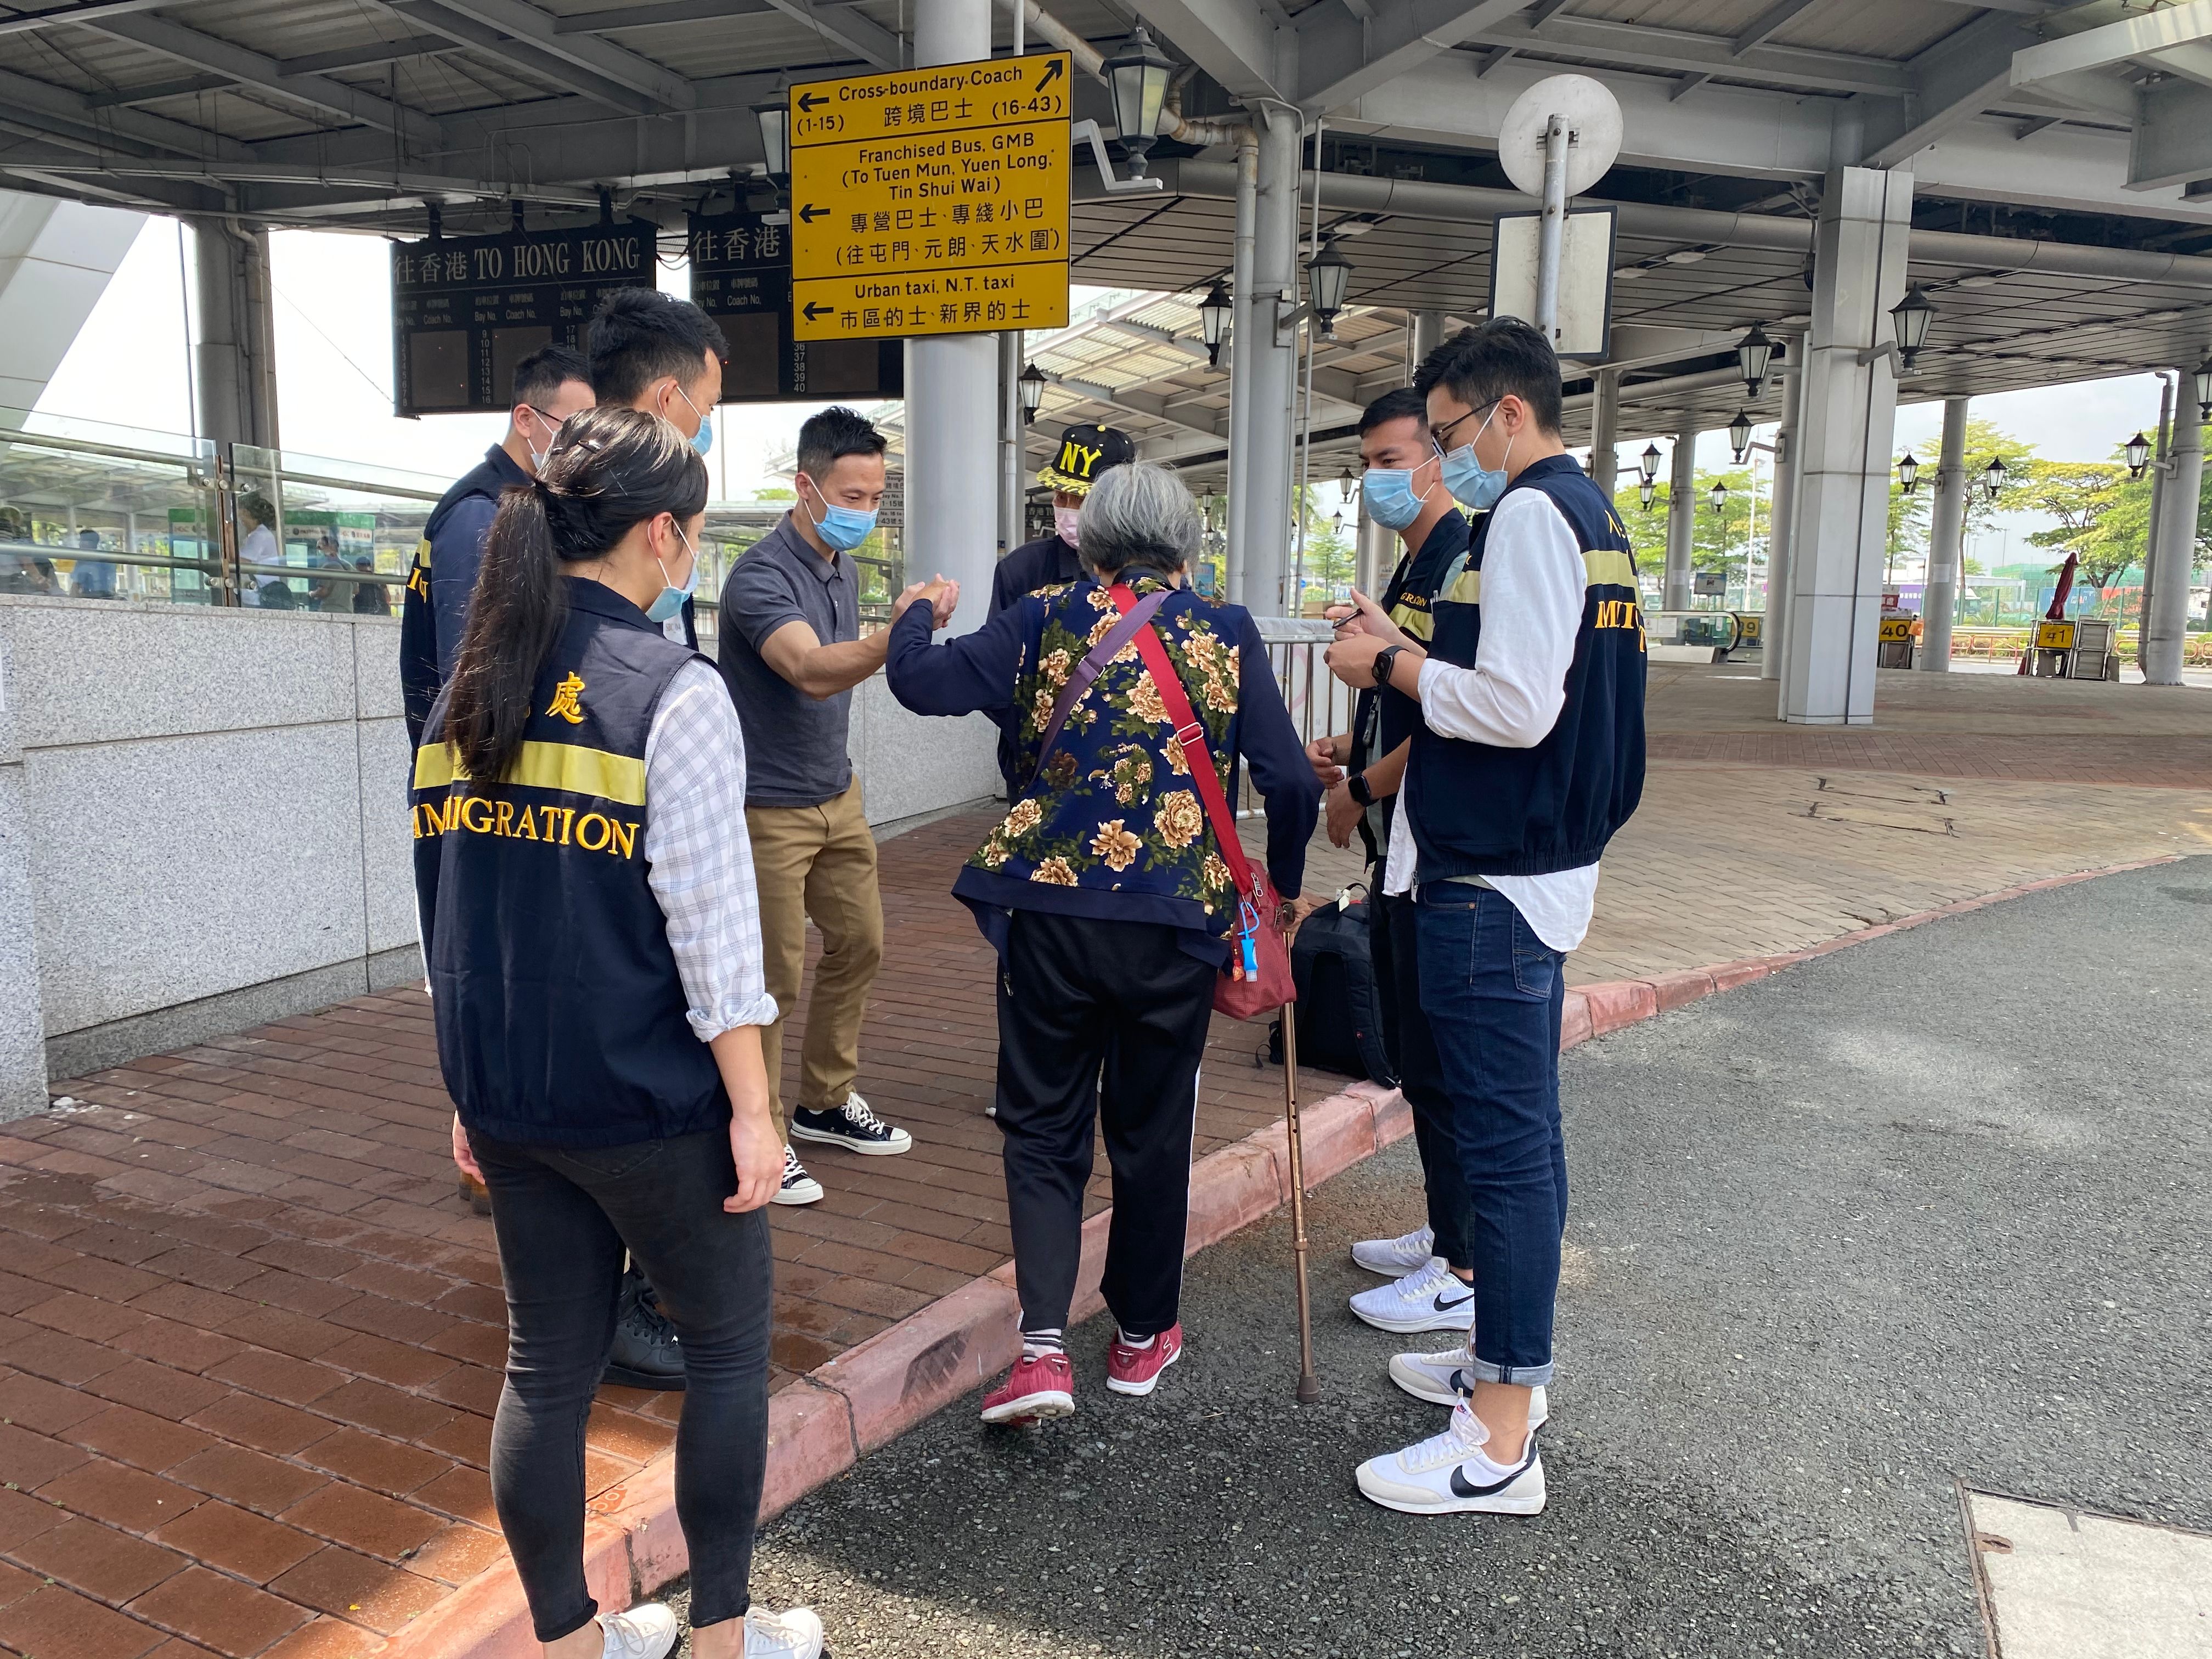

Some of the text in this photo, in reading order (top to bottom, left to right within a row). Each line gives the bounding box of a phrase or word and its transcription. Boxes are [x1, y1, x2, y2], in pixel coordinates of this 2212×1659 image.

[839, 66, 1022, 101] Cross-boundary Coach
[884, 98, 973, 127] 跨境巴士
[992, 96, 1062, 119] (16-43)
[798, 114, 844, 136] (1-15)
[859, 141, 945, 163] Franchised
[992, 133, 1034, 149] GMB
[842, 170, 868, 188] (To
[873, 167, 910, 182] Tuen
[961, 158, 1000, 173] Yuen
[889, 176, 1000, 200] Tin Shui Wai)
[692, 226, 780, 263] 往香港
[394, 238, 640, 284] 往香港 TO HONG KONG
[855, 284, 900, 298] Urban
[946, 277, 978, 292] N.T.
[983, 274, 1014, 290] taxi
[727, 294, 761, 306] Coach No.
[475, 312, 486, 323] Bay
[506, 309, 524, 320] Coach
[560, 306, 571, 318] Bay
[840, 299, 1030, 330] 市區的士、新界的士
[424, 314, 441, 325] Coach
[482, 330, 487, 338] 9
[566, 325, 575, 334] 17
[481, 339, 489, 348] 10
[566, 335, 575, 343] 18
[481, 349, 489, 357] 11
[794, 352, 805, 361] 37
[481, 358, 490, 366] 12
[794, 362, 805, 371] 38
[481, 368, 490, 376] 13
[794, 373, 805, 382] 39
[482, 377, 490, 385] 14
[482, 386, 490, 394] 15
[794, 383, 805, 392] 40
[1059, 442, 1102, 477] NY
[1881, 624, 1908, 637] 40
[545, 671, 586, 724] 處
